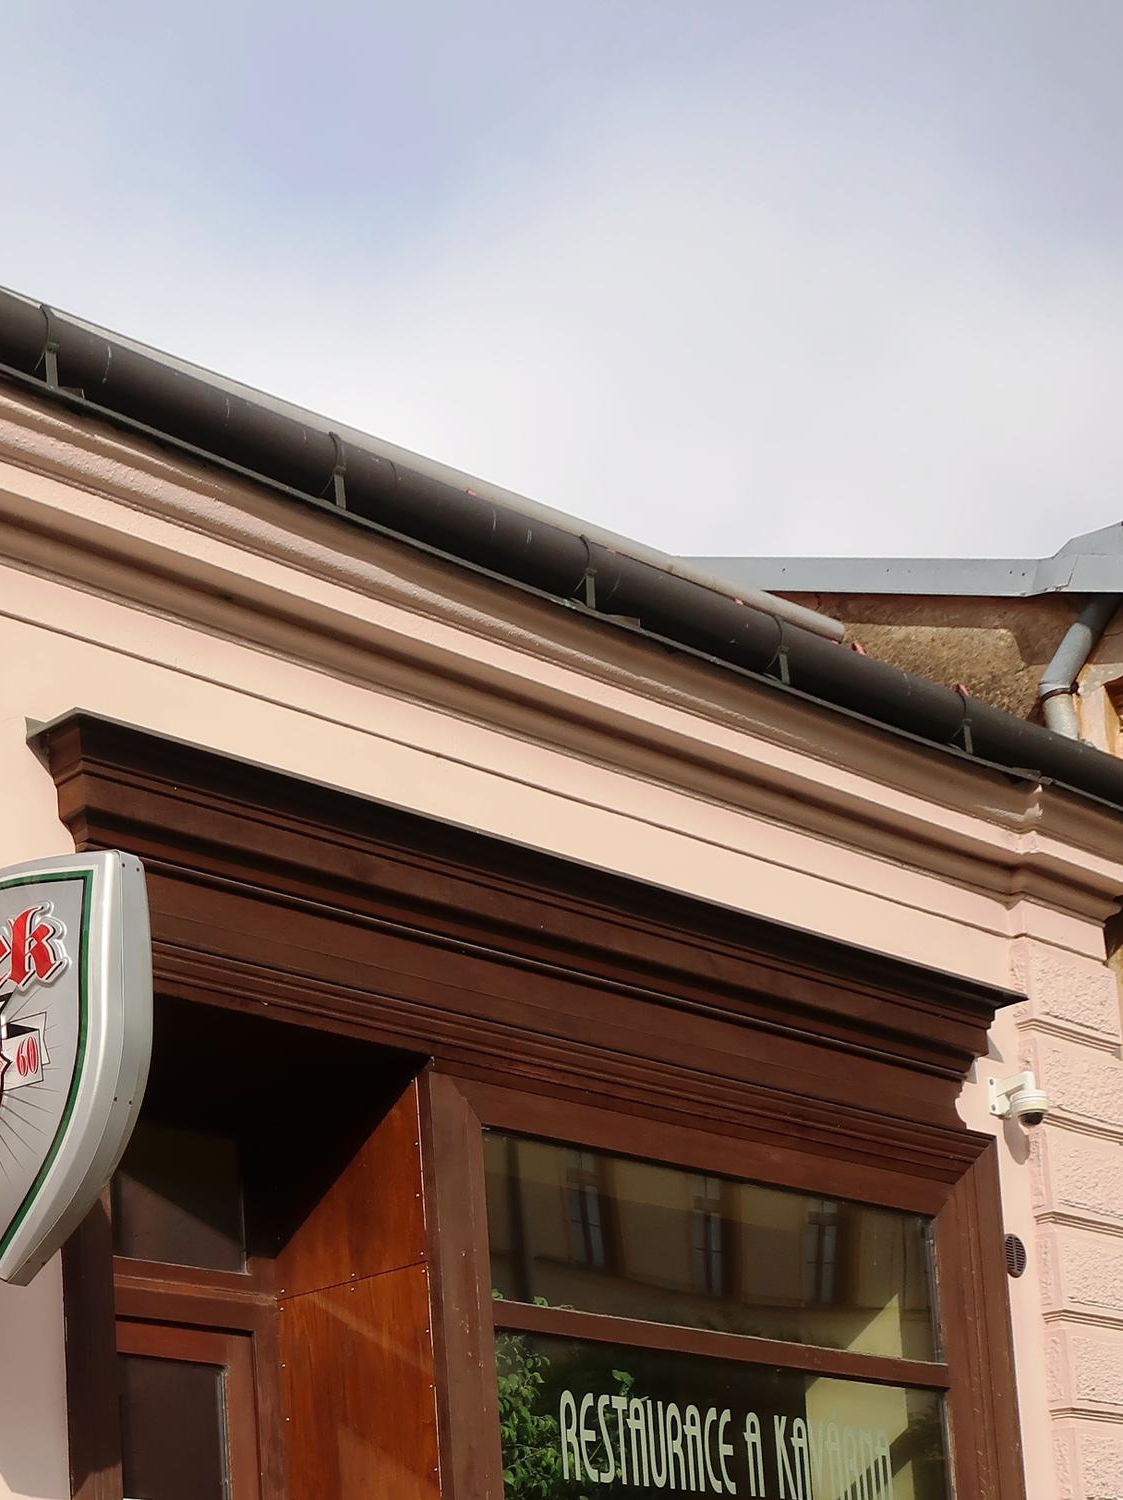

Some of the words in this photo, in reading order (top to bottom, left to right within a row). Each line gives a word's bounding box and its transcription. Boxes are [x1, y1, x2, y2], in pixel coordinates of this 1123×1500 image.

[16, 1036, 38, 1077] 60
[560, 1390, 736, 1495] RESTAURACE
[743, 1412, 766, 1498] A
